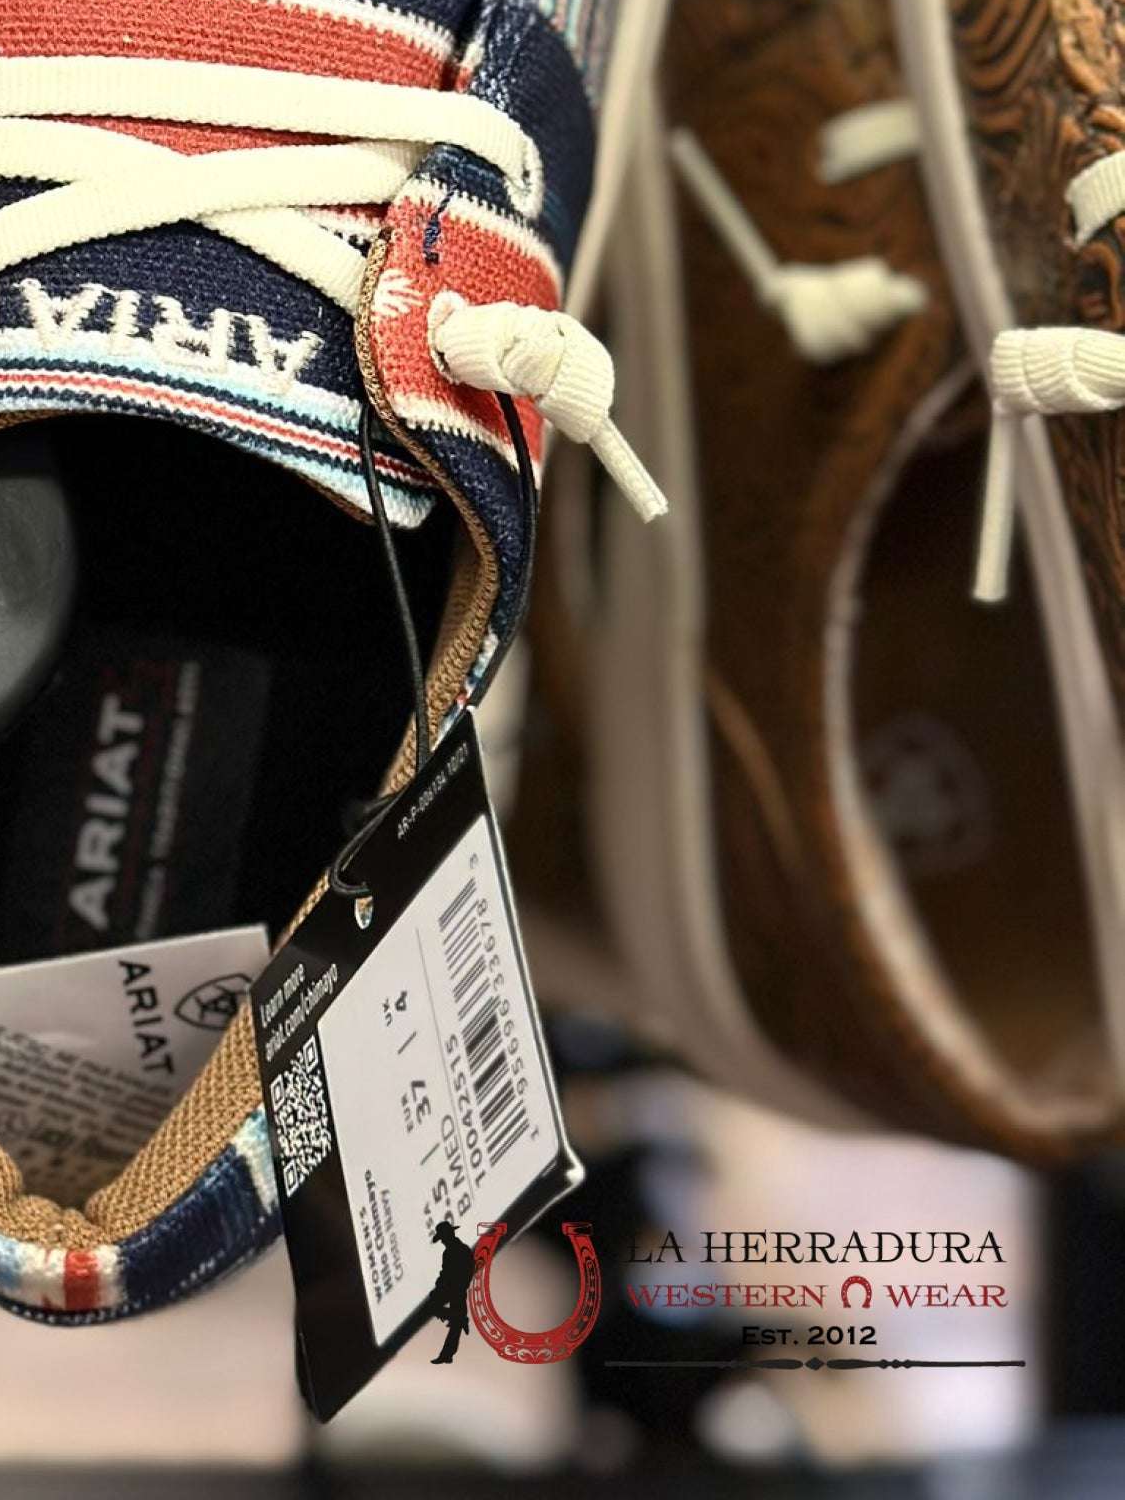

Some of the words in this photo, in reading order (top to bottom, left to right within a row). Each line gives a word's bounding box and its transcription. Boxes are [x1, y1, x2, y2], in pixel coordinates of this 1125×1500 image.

[68, 693, 145, 932] ARIAT
[118, 959, 174, 1075] ARIAT
[260, 988, 284, 1028] Learn
[283, 963, 304, 1001] more
[382, 998, 393, 1027] UK
[394, 990, 408, 1012] 4
[410, 1080, 432, 1126] 37
[445, 1033, 486, 1189] 10042515
[440, 1114, 465, 1189] MED
[364, 1169, 385, 1251] Chimayo
[457, 1192, 471, 1217] B
[359, 1205, 382, 1304] WOMEN'S
[380, 1252, 394, 1294] Hilo
